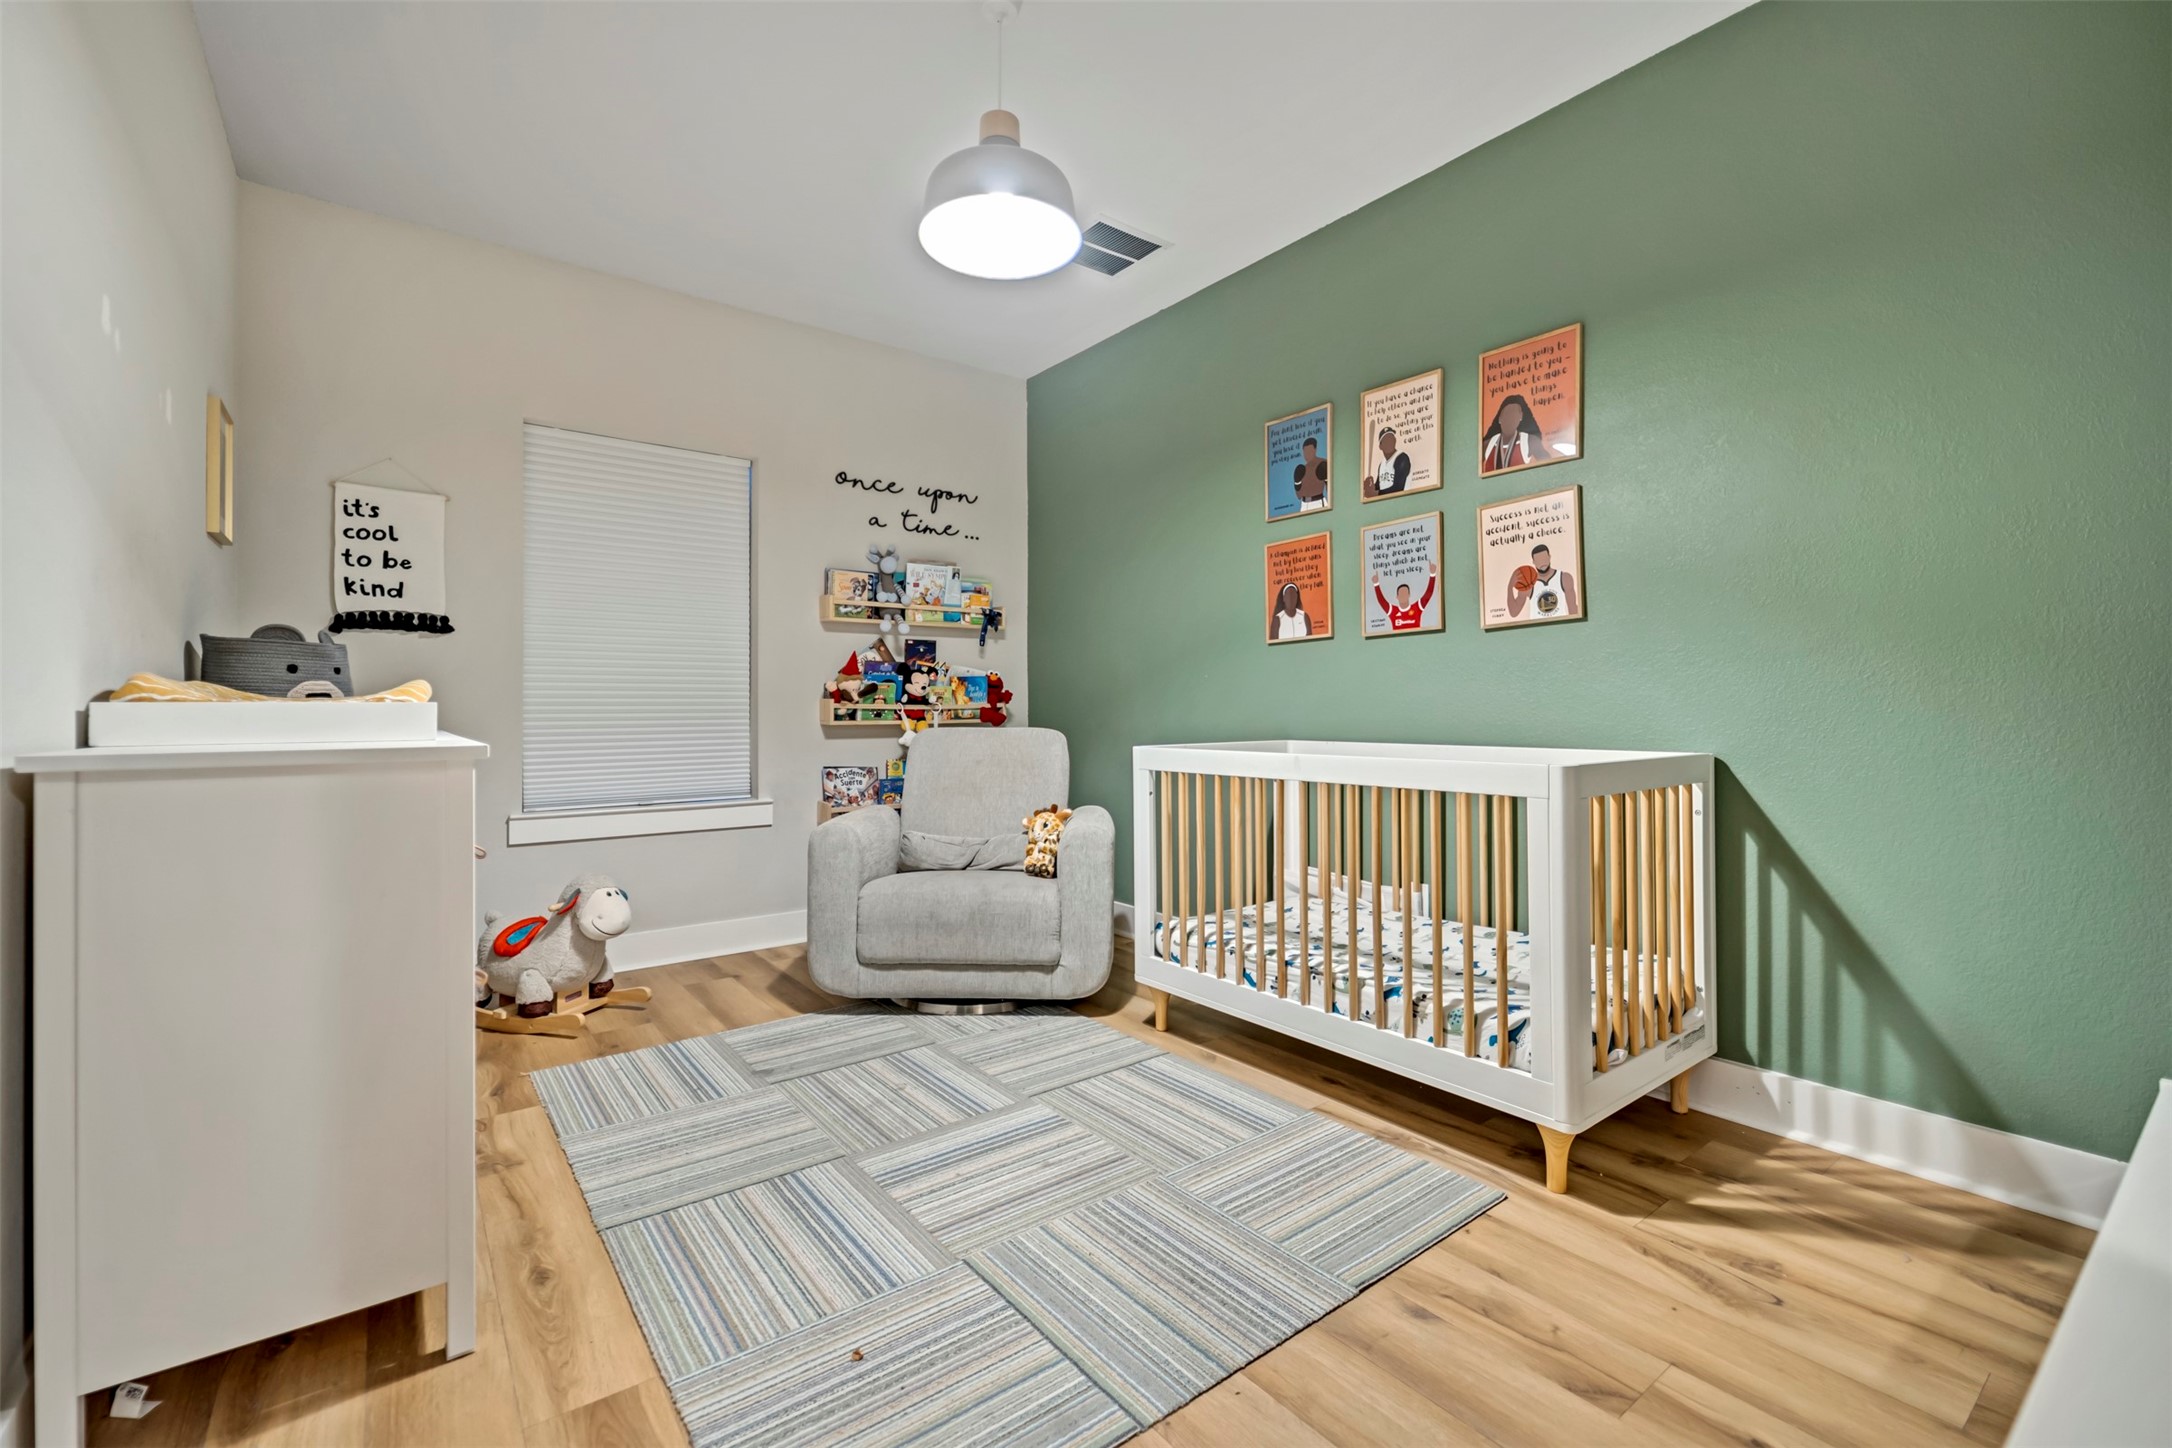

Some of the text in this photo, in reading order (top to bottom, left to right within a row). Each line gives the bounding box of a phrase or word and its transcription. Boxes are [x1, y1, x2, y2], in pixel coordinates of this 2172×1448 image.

[1488, 356, 1519, 371] Nothing
[1532, 345, 1554, 359] going
[1557, 342, 1567, 350] to
[1487, 374, 1496, 383] be
[1500, 364, 1531, 380] handed
[1534, 361, 1543, 370] to
[1547, 355, 1562, 369] you
[1490, 366, 1567, 398] you have to make
[1531, 383, 1556, 396] things
[1374, 399, 1384, 408] you
[1385, 394, 1401, 402] have
[1410, 384, 1433, 395] chance
[1388, 401, 1407, 412] others
[1409, 396, 1421, 406] and
[1422, 392, 1433, 403] fail
[1404, 409, 1415, 419] you
[1417, 404, 1429, 414] are
[1395, 414, 1433, 428] wasting your
[1399, 421, 1434, 437] time on this
[835, 471, 978, 514] once upon
[343, 498, 380, 518] it's
[1490, 511, 1522, 523] Success
[1534, 504, 1548, 514] not
[1552, 502, 1564, 510] an
[868, 516, 887, 527] a
[1526, 515, 1560, 527] success
[343, 525, 399, 542] cool
[1373, 531, 1397, 541] Dreams
[1412, 525, 1424, 533] not
[1490, 534, 1526, 547] actually
[1305, 543, 1325, 552] defined
[1369, 543, 1383, 551] what
[1385, 541, 1396, 551] you
[1397, 537, 1408, 546] see
[1417, 535, 1431, 544] your
[1392, 547, 1414, 557] dreams
[1415, 545, 1426, 553] are
[341, 548, 412, 570] to be
[1284, 559, 1291, 567] by
[1373, 561, 1390, 570] things
[1392, 557, 1408, 566] which
[1286, 567, 1293, 576] by
[1305, 564, 1318, 572] they
[1383, 568, 1392, 576] let
[1394, 567, 1405, 577] you
[1283, 575, 1305, 583] recover
[343, 576, 404, 599] kind
[834, 769, 866, 780] Accidente
